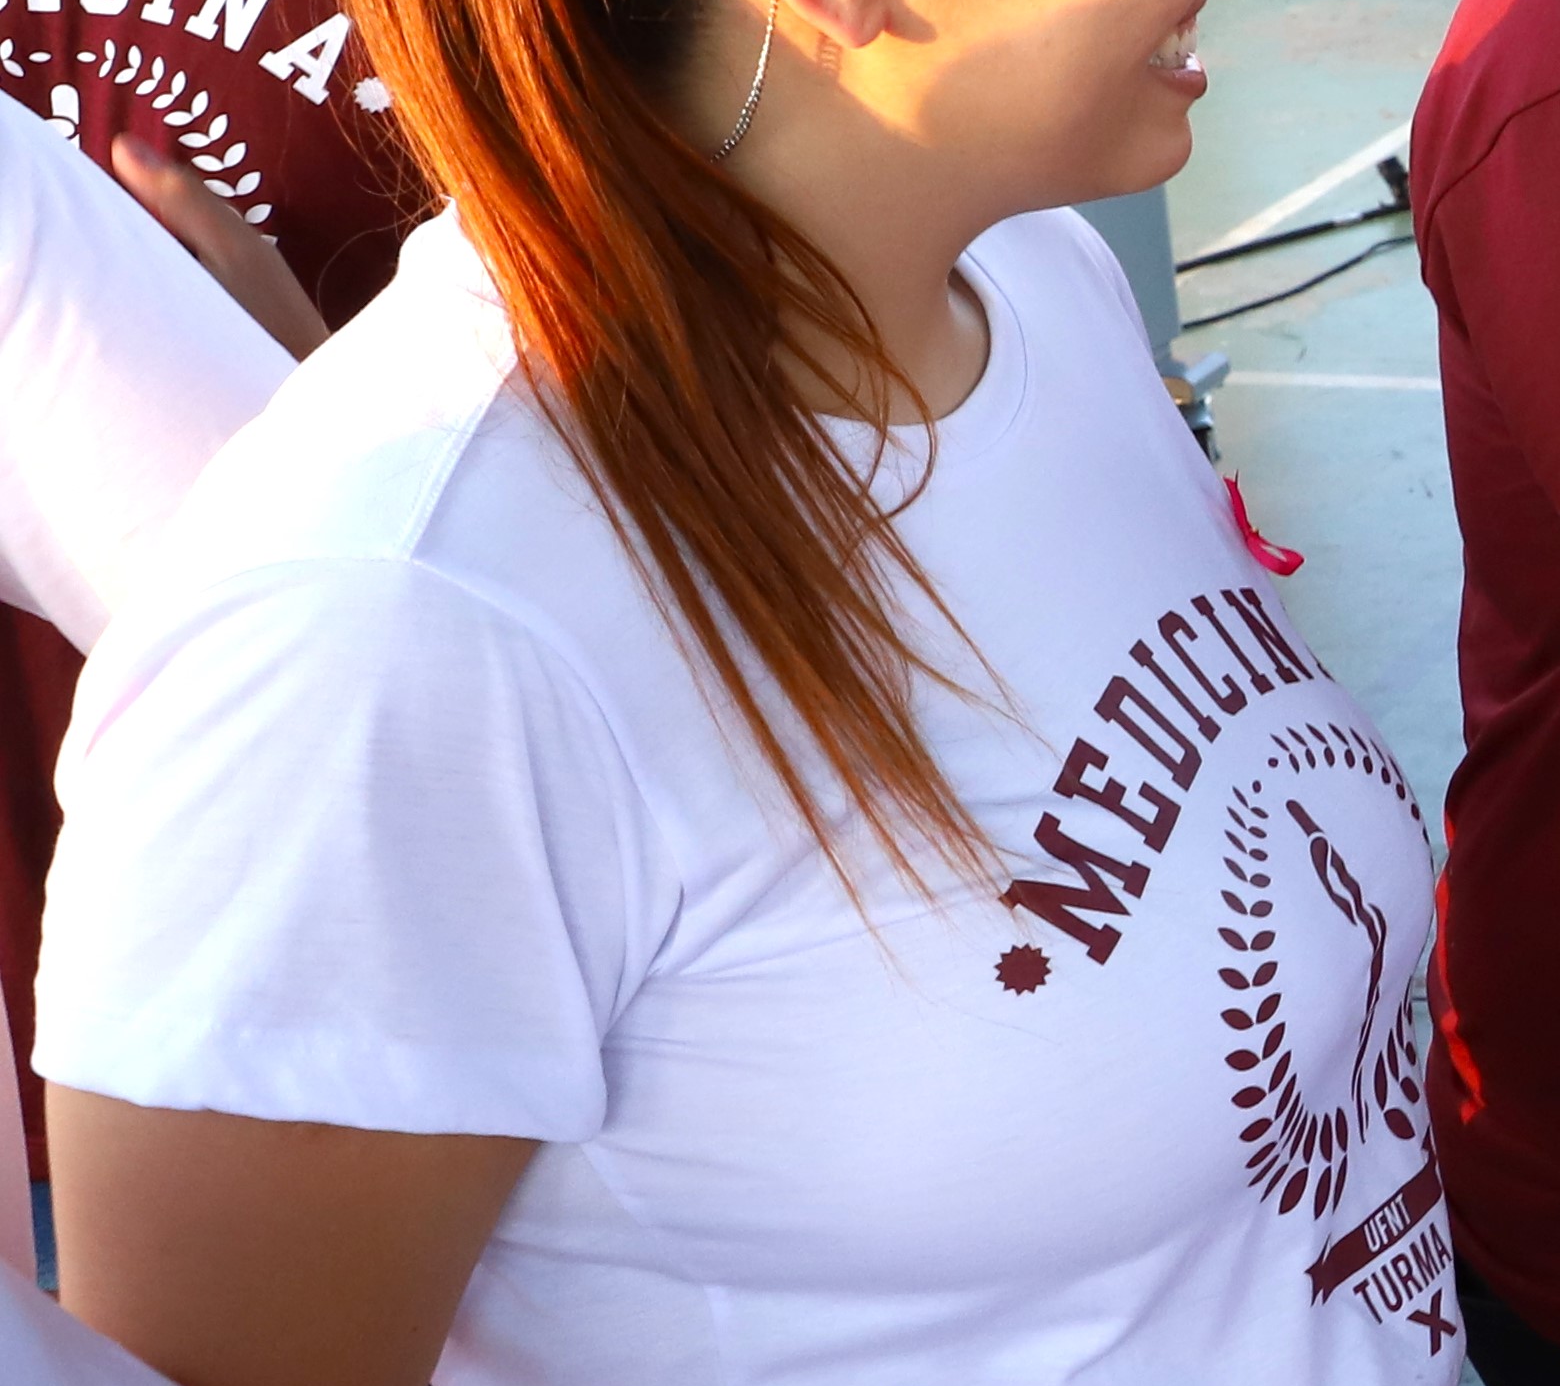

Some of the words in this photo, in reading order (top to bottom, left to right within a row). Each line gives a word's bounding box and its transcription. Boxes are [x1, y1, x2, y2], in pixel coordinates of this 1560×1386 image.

[1000, 587, 1331, 966] MEDICIN
[1363, 1191, 1412, 1254] UFNT
[1352, 1221, 1453, 1326] TURMA
[1406, 1286, 1458, 1358] X
